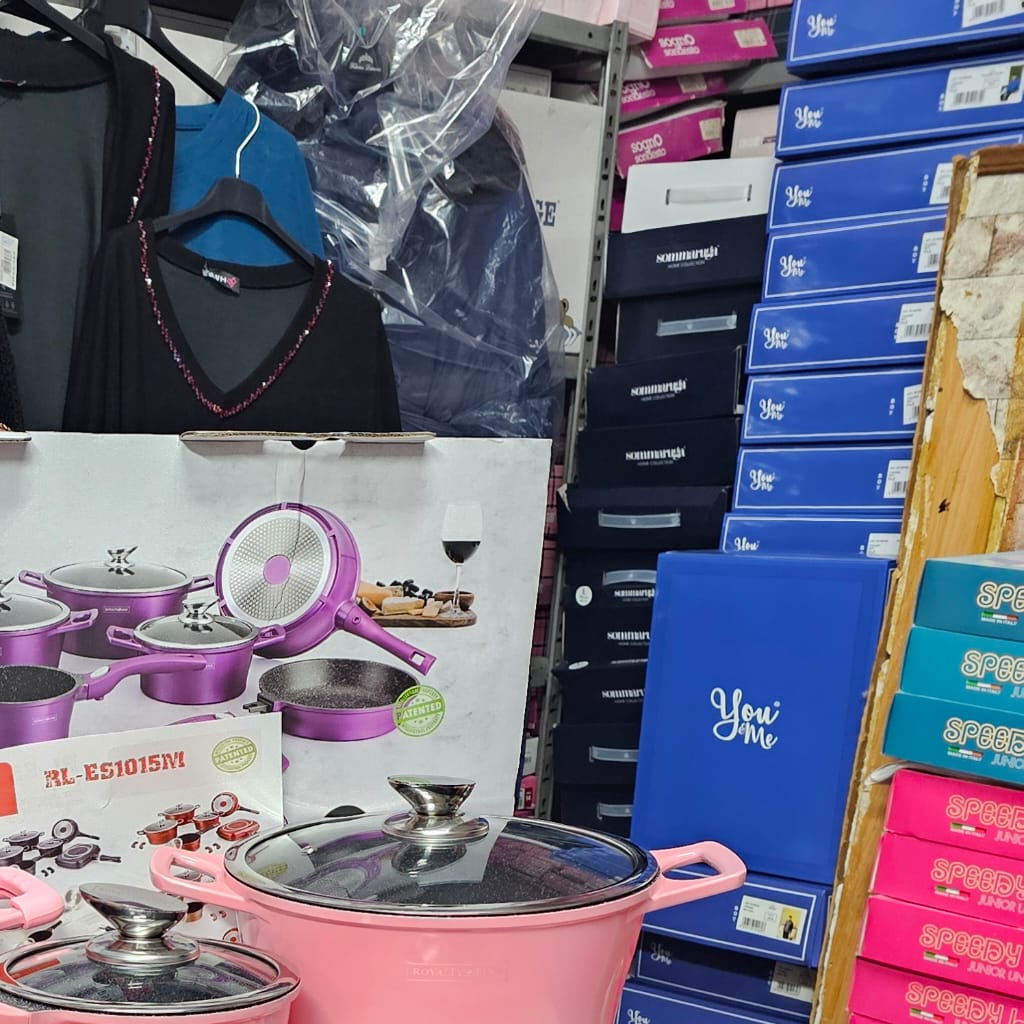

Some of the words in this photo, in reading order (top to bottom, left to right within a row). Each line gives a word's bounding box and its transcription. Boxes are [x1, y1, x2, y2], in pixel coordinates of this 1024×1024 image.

[976, 580, 1024, 612] SPE
[960, 650, 1024, 685] SPEE
[396, 702, 442, 721] PATENTED
[710, 687, 780, 741] You
[943, 716, 1024, 757] SPEED
[43, 751, 186, 789] RL-ES1015M
[214, 745, 257, 764] PATENTED
[946, 794, 1024, 833] SPEED
[977, 894, 1016, 912] JUNIOR
[919, 924, 1023, 973] SPEEDY
[967, 960, 1007, 980] JUNIOR
